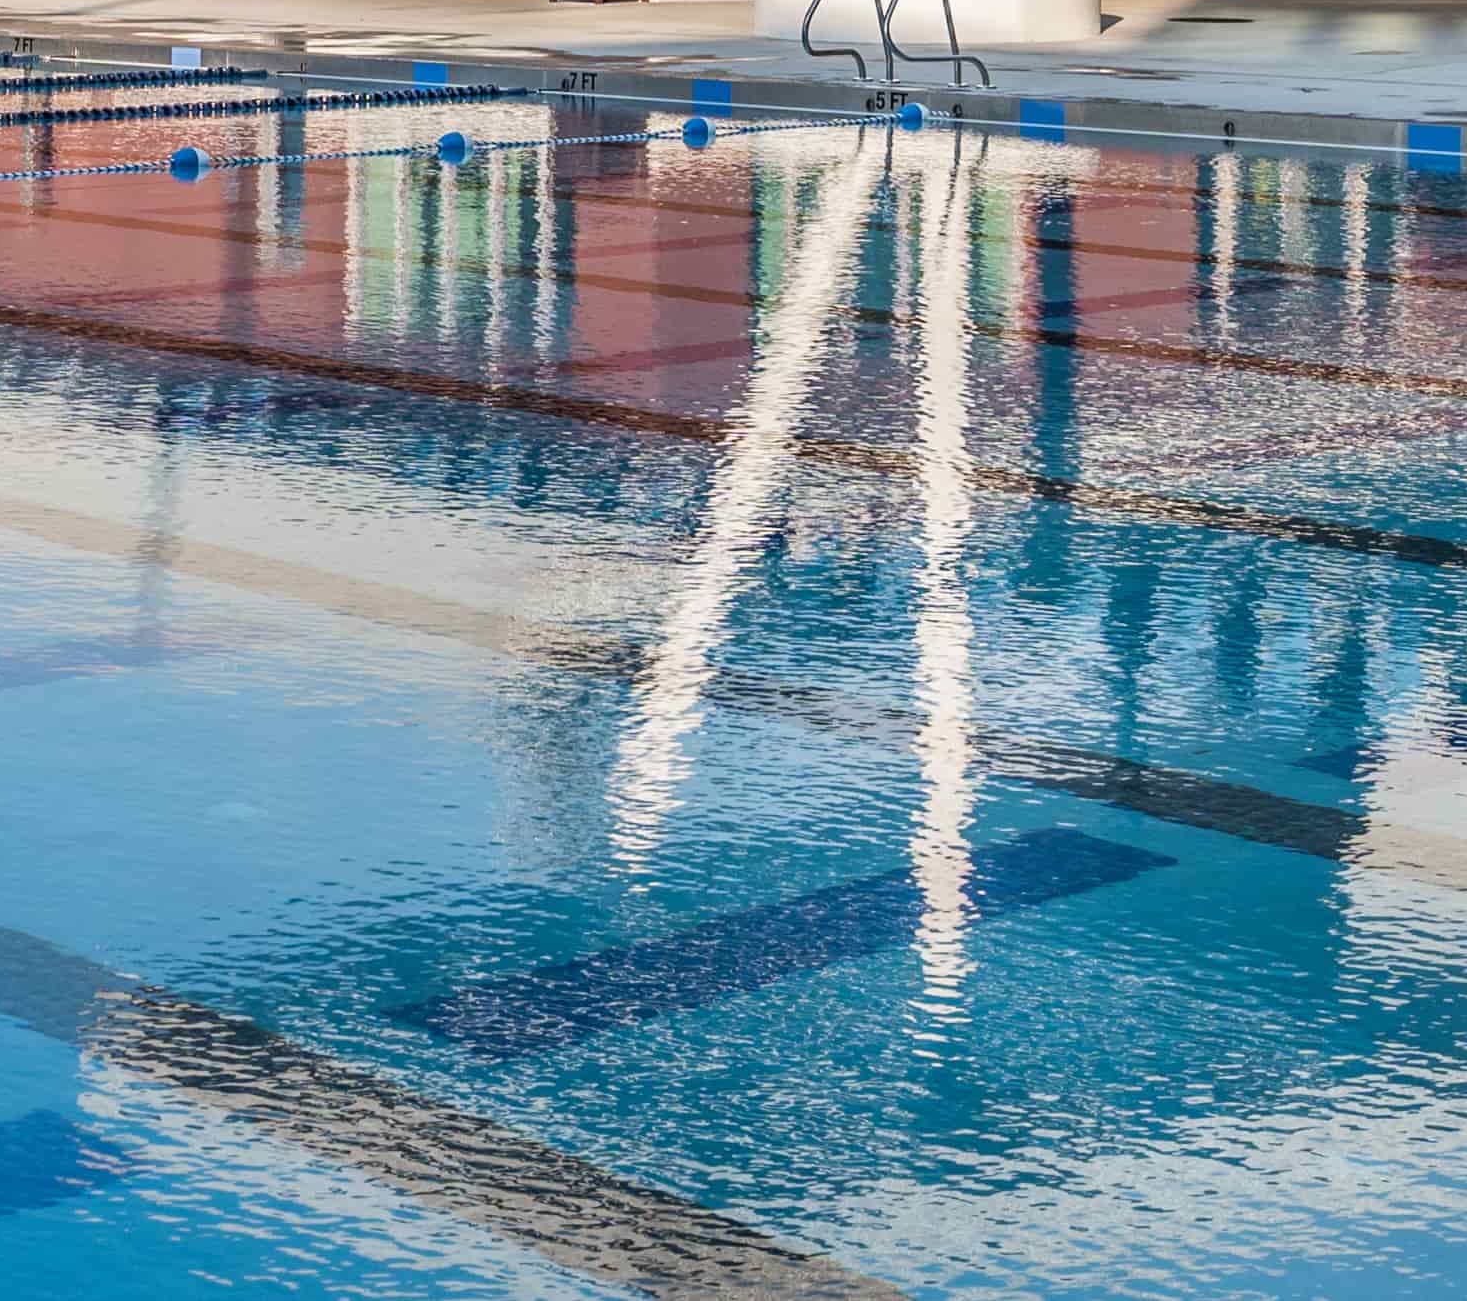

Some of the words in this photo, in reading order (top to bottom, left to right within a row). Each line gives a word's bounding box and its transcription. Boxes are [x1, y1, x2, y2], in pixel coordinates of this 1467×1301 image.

[14, 37, 21, 52] 7
[22, 37, 35, 54] FT
[569, 71, 578, 90] 7
[581, 72, 598, 91] FT
[875, 91, 886, 111] 5
[890, 92, 909, 111] FT
